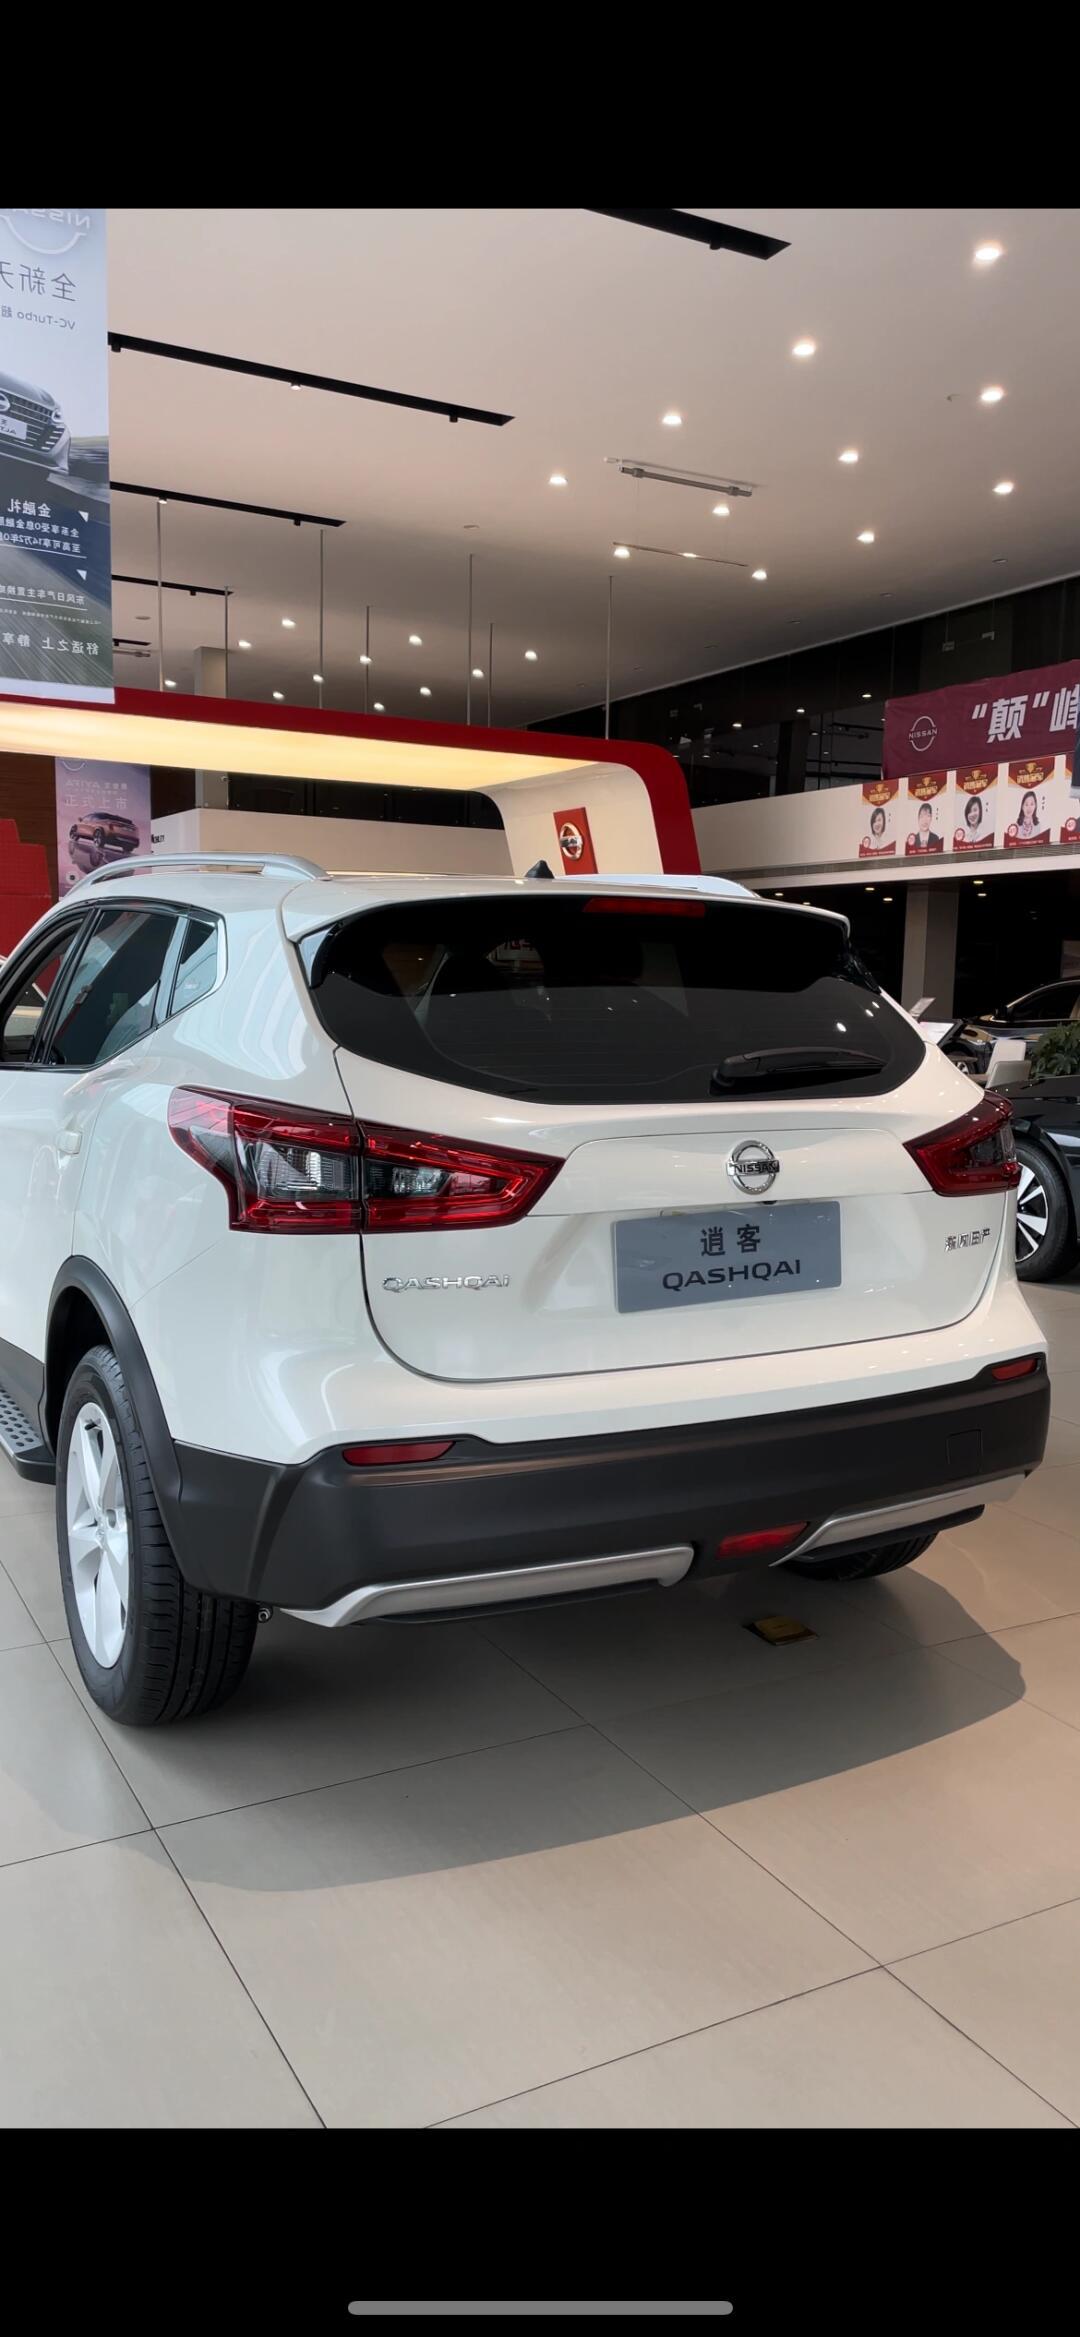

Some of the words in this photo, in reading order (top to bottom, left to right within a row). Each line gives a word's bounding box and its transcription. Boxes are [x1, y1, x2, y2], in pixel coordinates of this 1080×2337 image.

[908, 727, 938, 740] NISSAN
[734, 1160, 778, 1174] NISSAN
[700, 1223, 761, 1257] 逍客
[662, 1259, 801, 1292] QASHQAI
